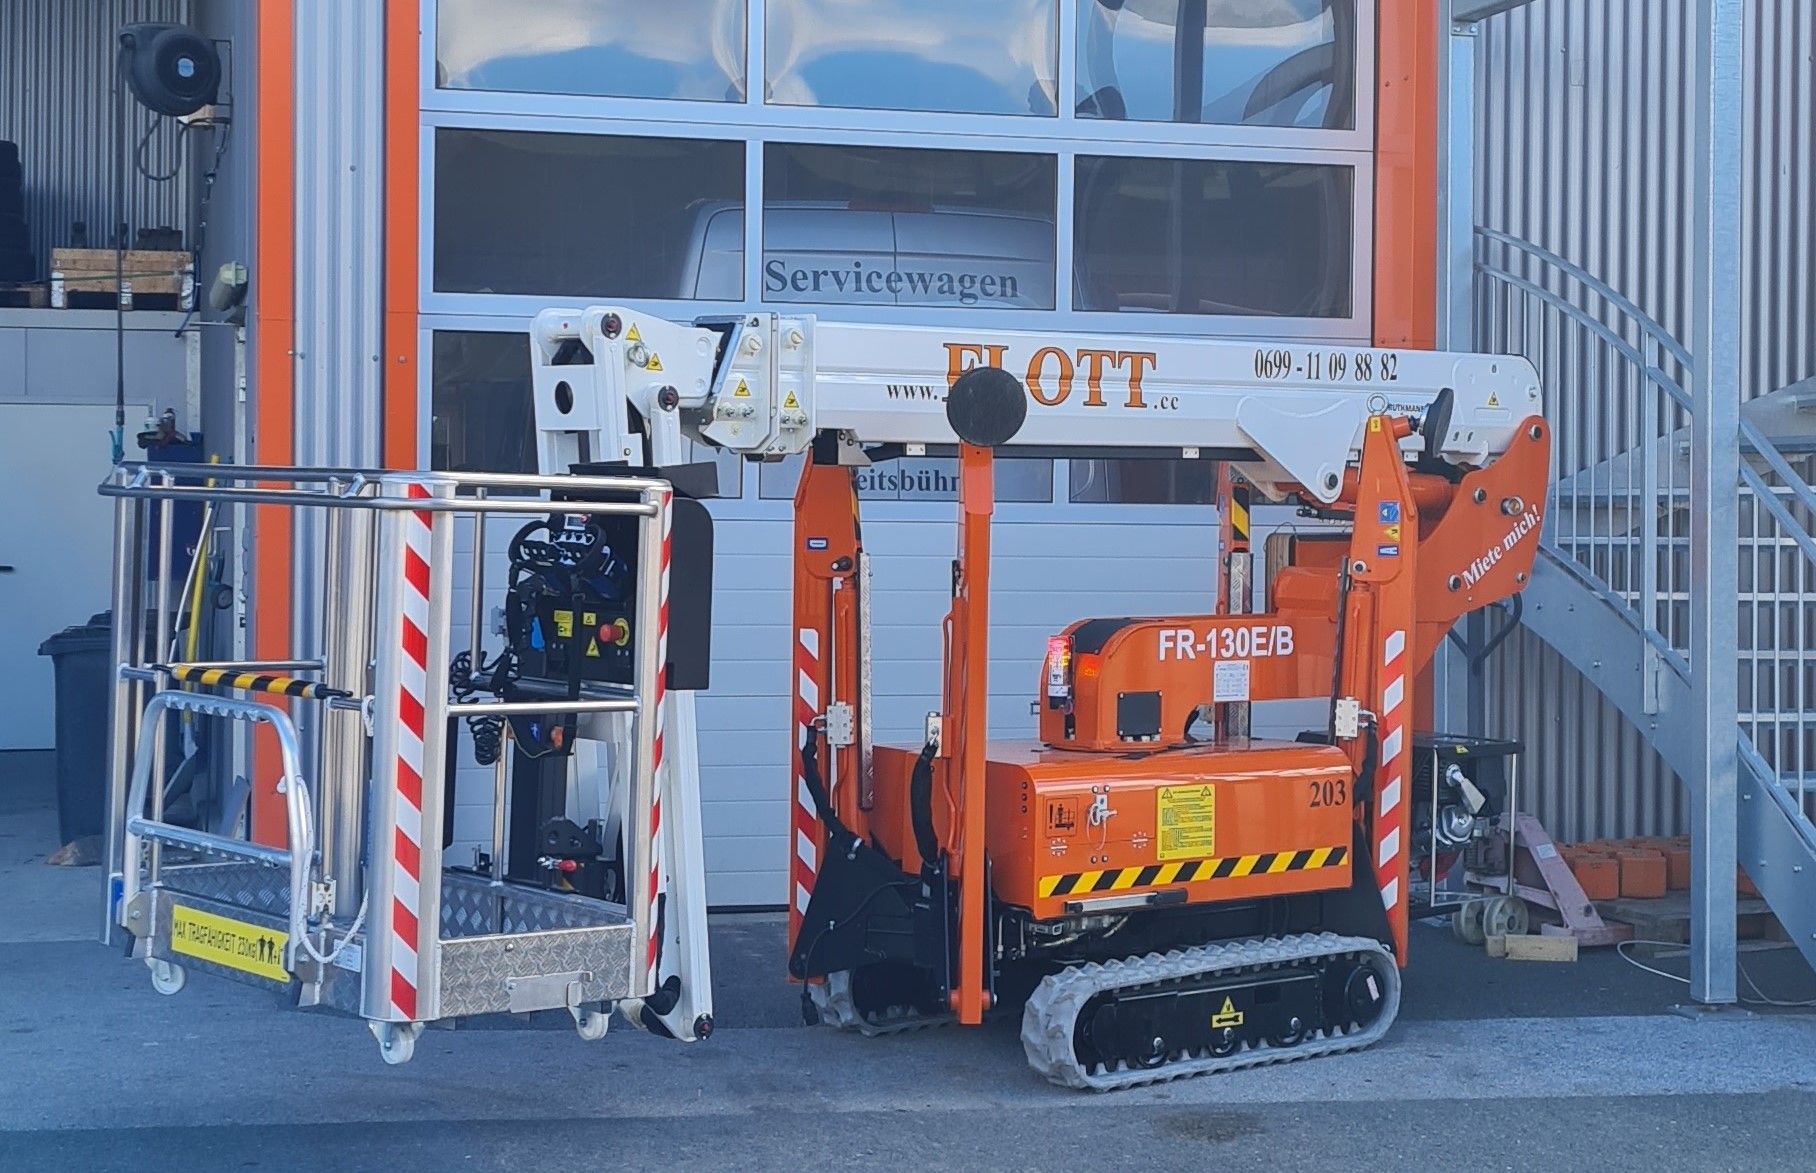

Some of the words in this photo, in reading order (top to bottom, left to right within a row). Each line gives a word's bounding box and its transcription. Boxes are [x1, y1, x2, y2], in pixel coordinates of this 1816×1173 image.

[765, 259, 1018, 304] Servicewagen
[1328, 352, 1347, 381] 09
[1354, 352, 1373, 381] 88
[1380, 352, 1398, 381] 82
[1461, 546, 1503, 590] Miete
[1503, 503, 1541, 552] mich!
[1158, 625, 1294, 661] FR-130E/B
[1309, 779, 1347, 808] 203
